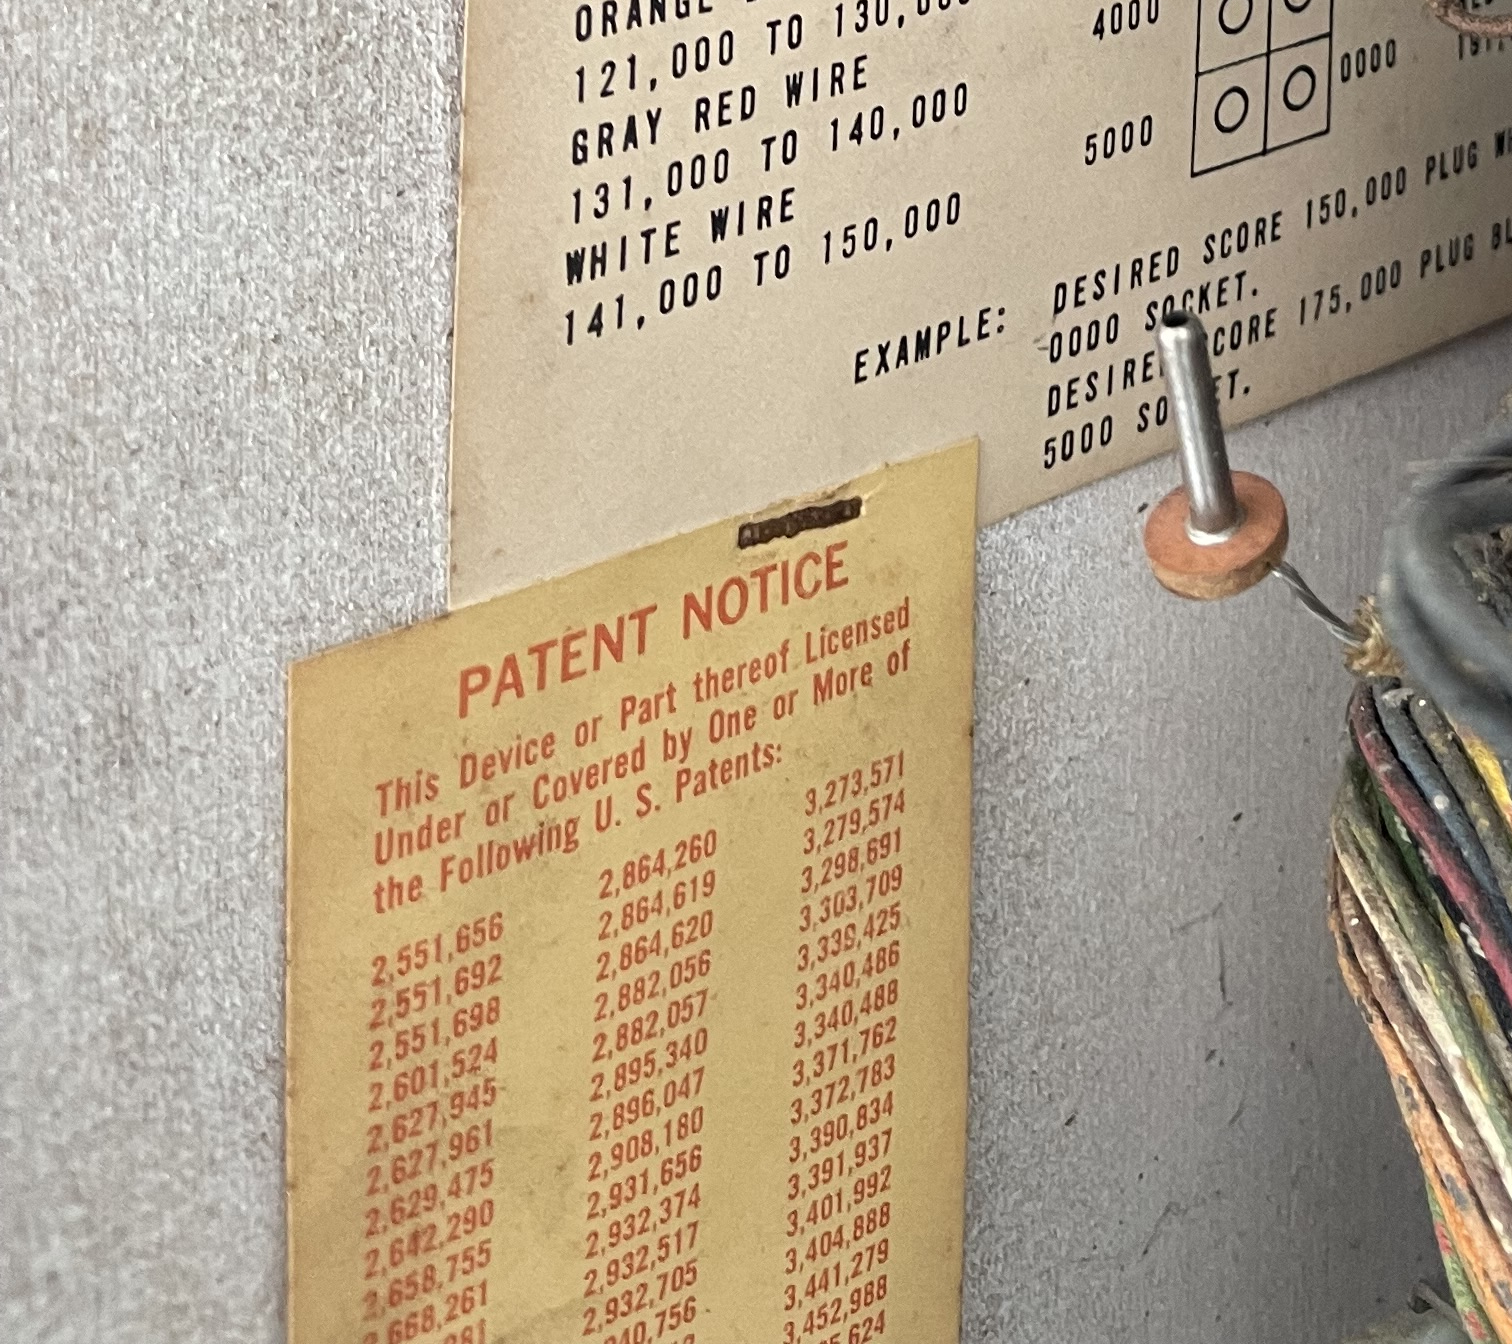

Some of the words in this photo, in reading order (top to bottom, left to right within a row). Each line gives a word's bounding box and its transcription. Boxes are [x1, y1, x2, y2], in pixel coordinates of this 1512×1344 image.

[1340, 38, 1397, 84] 0000
[571, 107, 663, 166] GRAY
[694, 84, 756, 134] RED
[785, 53, 868, 109] WIRE
[1084, 114, 1153, 166] 5000
[565, 219, 682, 287] WHITE
[710, 186, 796, 244] WIRE
[1053, 245, 1180, 316] DESIRED
[1202, 210, 1283, 265] SCORE
[1306, 165, 1407, 230] 150,000
[1424, 140, 1478, 186] PLUG
[565, 264, 722, 346] 141,000
[753, 243, 791, 287] TO
[823, 191, 961, 266] 150,000
[1299, 259, 1402, 326] 175,000
[1419, 232, 1474, 280] PLUG
[854, 306, 1006, 385] EXAMPLE:
[1049, 312, 1120, 364] 0000
[1043, 414, 1113, 470] 5000
[456, 603, 658, 720] PATENT
[680, 538, 849, 641] NOTICE
[374, 768, 440, 818] This
[458, 731, 557, 789] Device
[573, 715, 603, 748] or
[618, 681, 678, 732] Part
[692, 639, 790, 704] thereof
[804, 596, 912, 665] Licensed
[373, 812, 465, 868] Under
[484, 795, 513, 828] or
[532, 736, 647, 810] Covered
[662, 729, 692, 764] by
[708, 705, 758, 744] One
[771, 689, 799, 721] or
[811, 662, 874, 706] More
[885, 638, 912, 677] of
[804, 751, 906, 820] 3,273,571
[372, 875, 424, 916] the
[434, 812, 580, 893] Following
[593, 795, 622, 834] U.
[634, 782, 661, 820] S.
[674, 742, 782, 803] Patents:
[598, 827, 719, 901] 2,864,260
[801, 826, 903, 895] 3,298,691
[371, 911, 505, 987] 2,551,656
[368, 995, 502, 1072] 2,551,698
[792, 1016, 897, 1088] 3,371,762
[587, 1106, 705, 1186] 2,908,180
[787, 1128, 893, 1204] 3,391,937
[788, 1091, 894, 1165] 3,390,834
[585, 1183, 703, 1262] 2,932,374
[586, 1143, 704, 1224] 2,931,656
